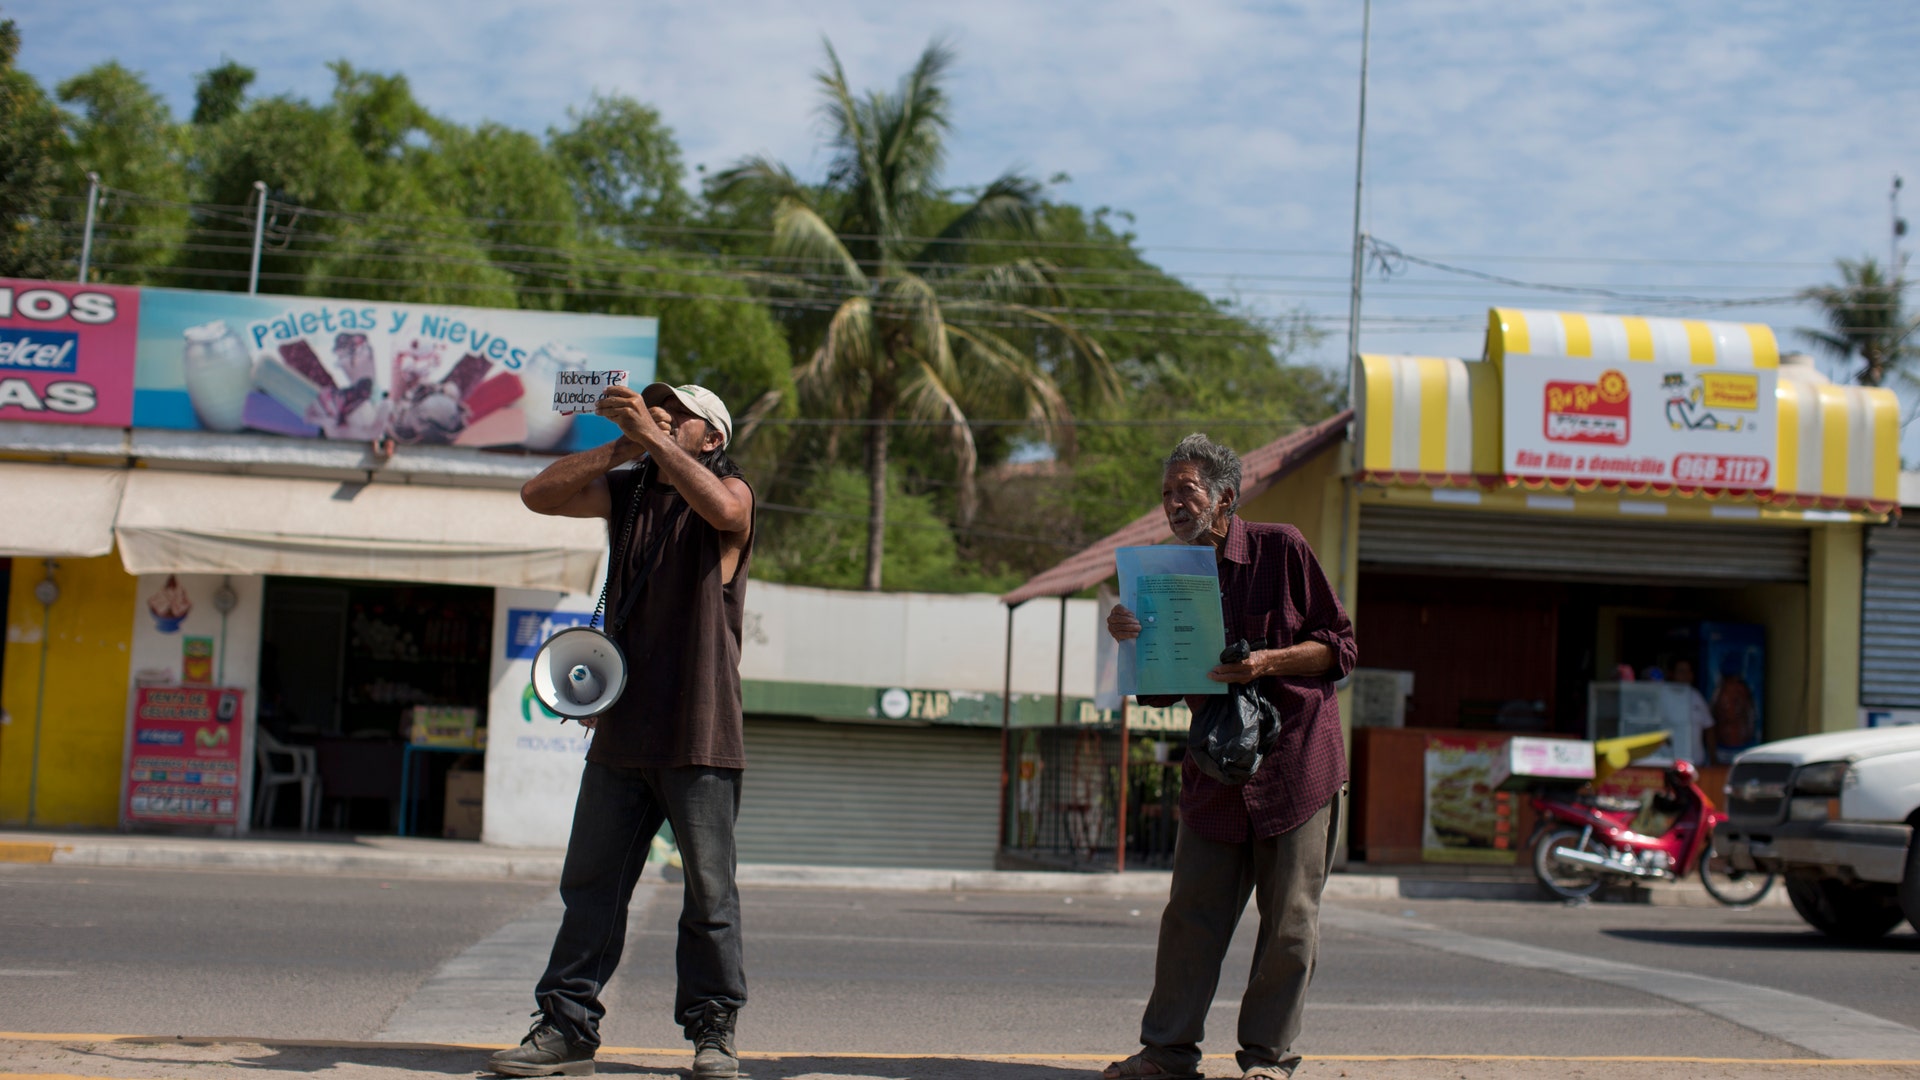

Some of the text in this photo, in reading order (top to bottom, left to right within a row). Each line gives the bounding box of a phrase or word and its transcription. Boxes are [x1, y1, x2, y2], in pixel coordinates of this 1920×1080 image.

[0, 337, 75, 368] elcel
[252, 307, 527, 370] Paletas y Nieves
[1515, 450, 1543, 468] Rin
[1545, 452, 1573, 469] Rin
[1575, 456, 1586, 470] a
[1588, 455, 1666, 475] domicilio
